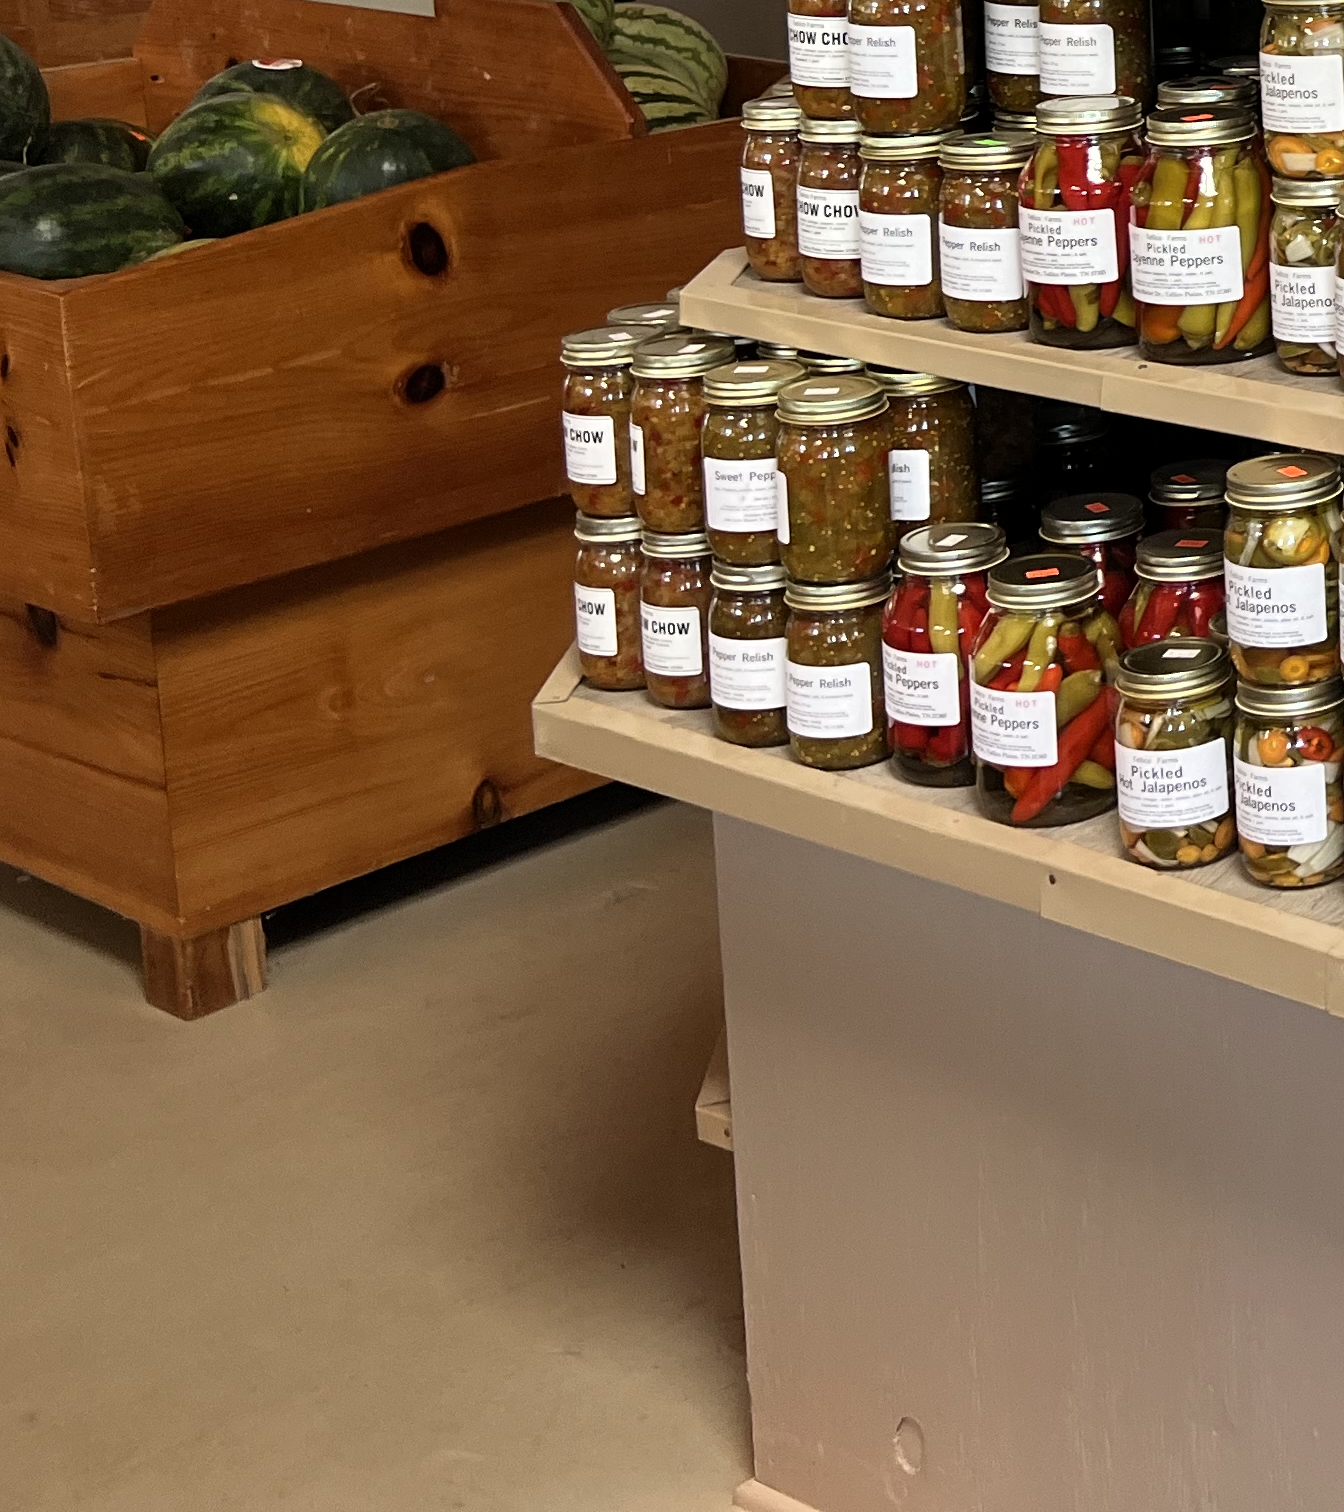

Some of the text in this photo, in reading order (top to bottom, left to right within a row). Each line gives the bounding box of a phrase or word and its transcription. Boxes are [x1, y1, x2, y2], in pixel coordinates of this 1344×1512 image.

[1047, 235, 1098, 249] Peppers
[1170, 252, 1224, 268] Peppers
[569, 429, 604, 445] CHOW
[714, 469, 743, 483] Sweet
[1235, 600, 1297, 615] Jalapenos
[652, 621, 690, 637] CHOW
[742, 650, 773, 664] Relish
[991, 716, 1039, 731] Peppers
[1131, 765, 1183, 780] Pickled
